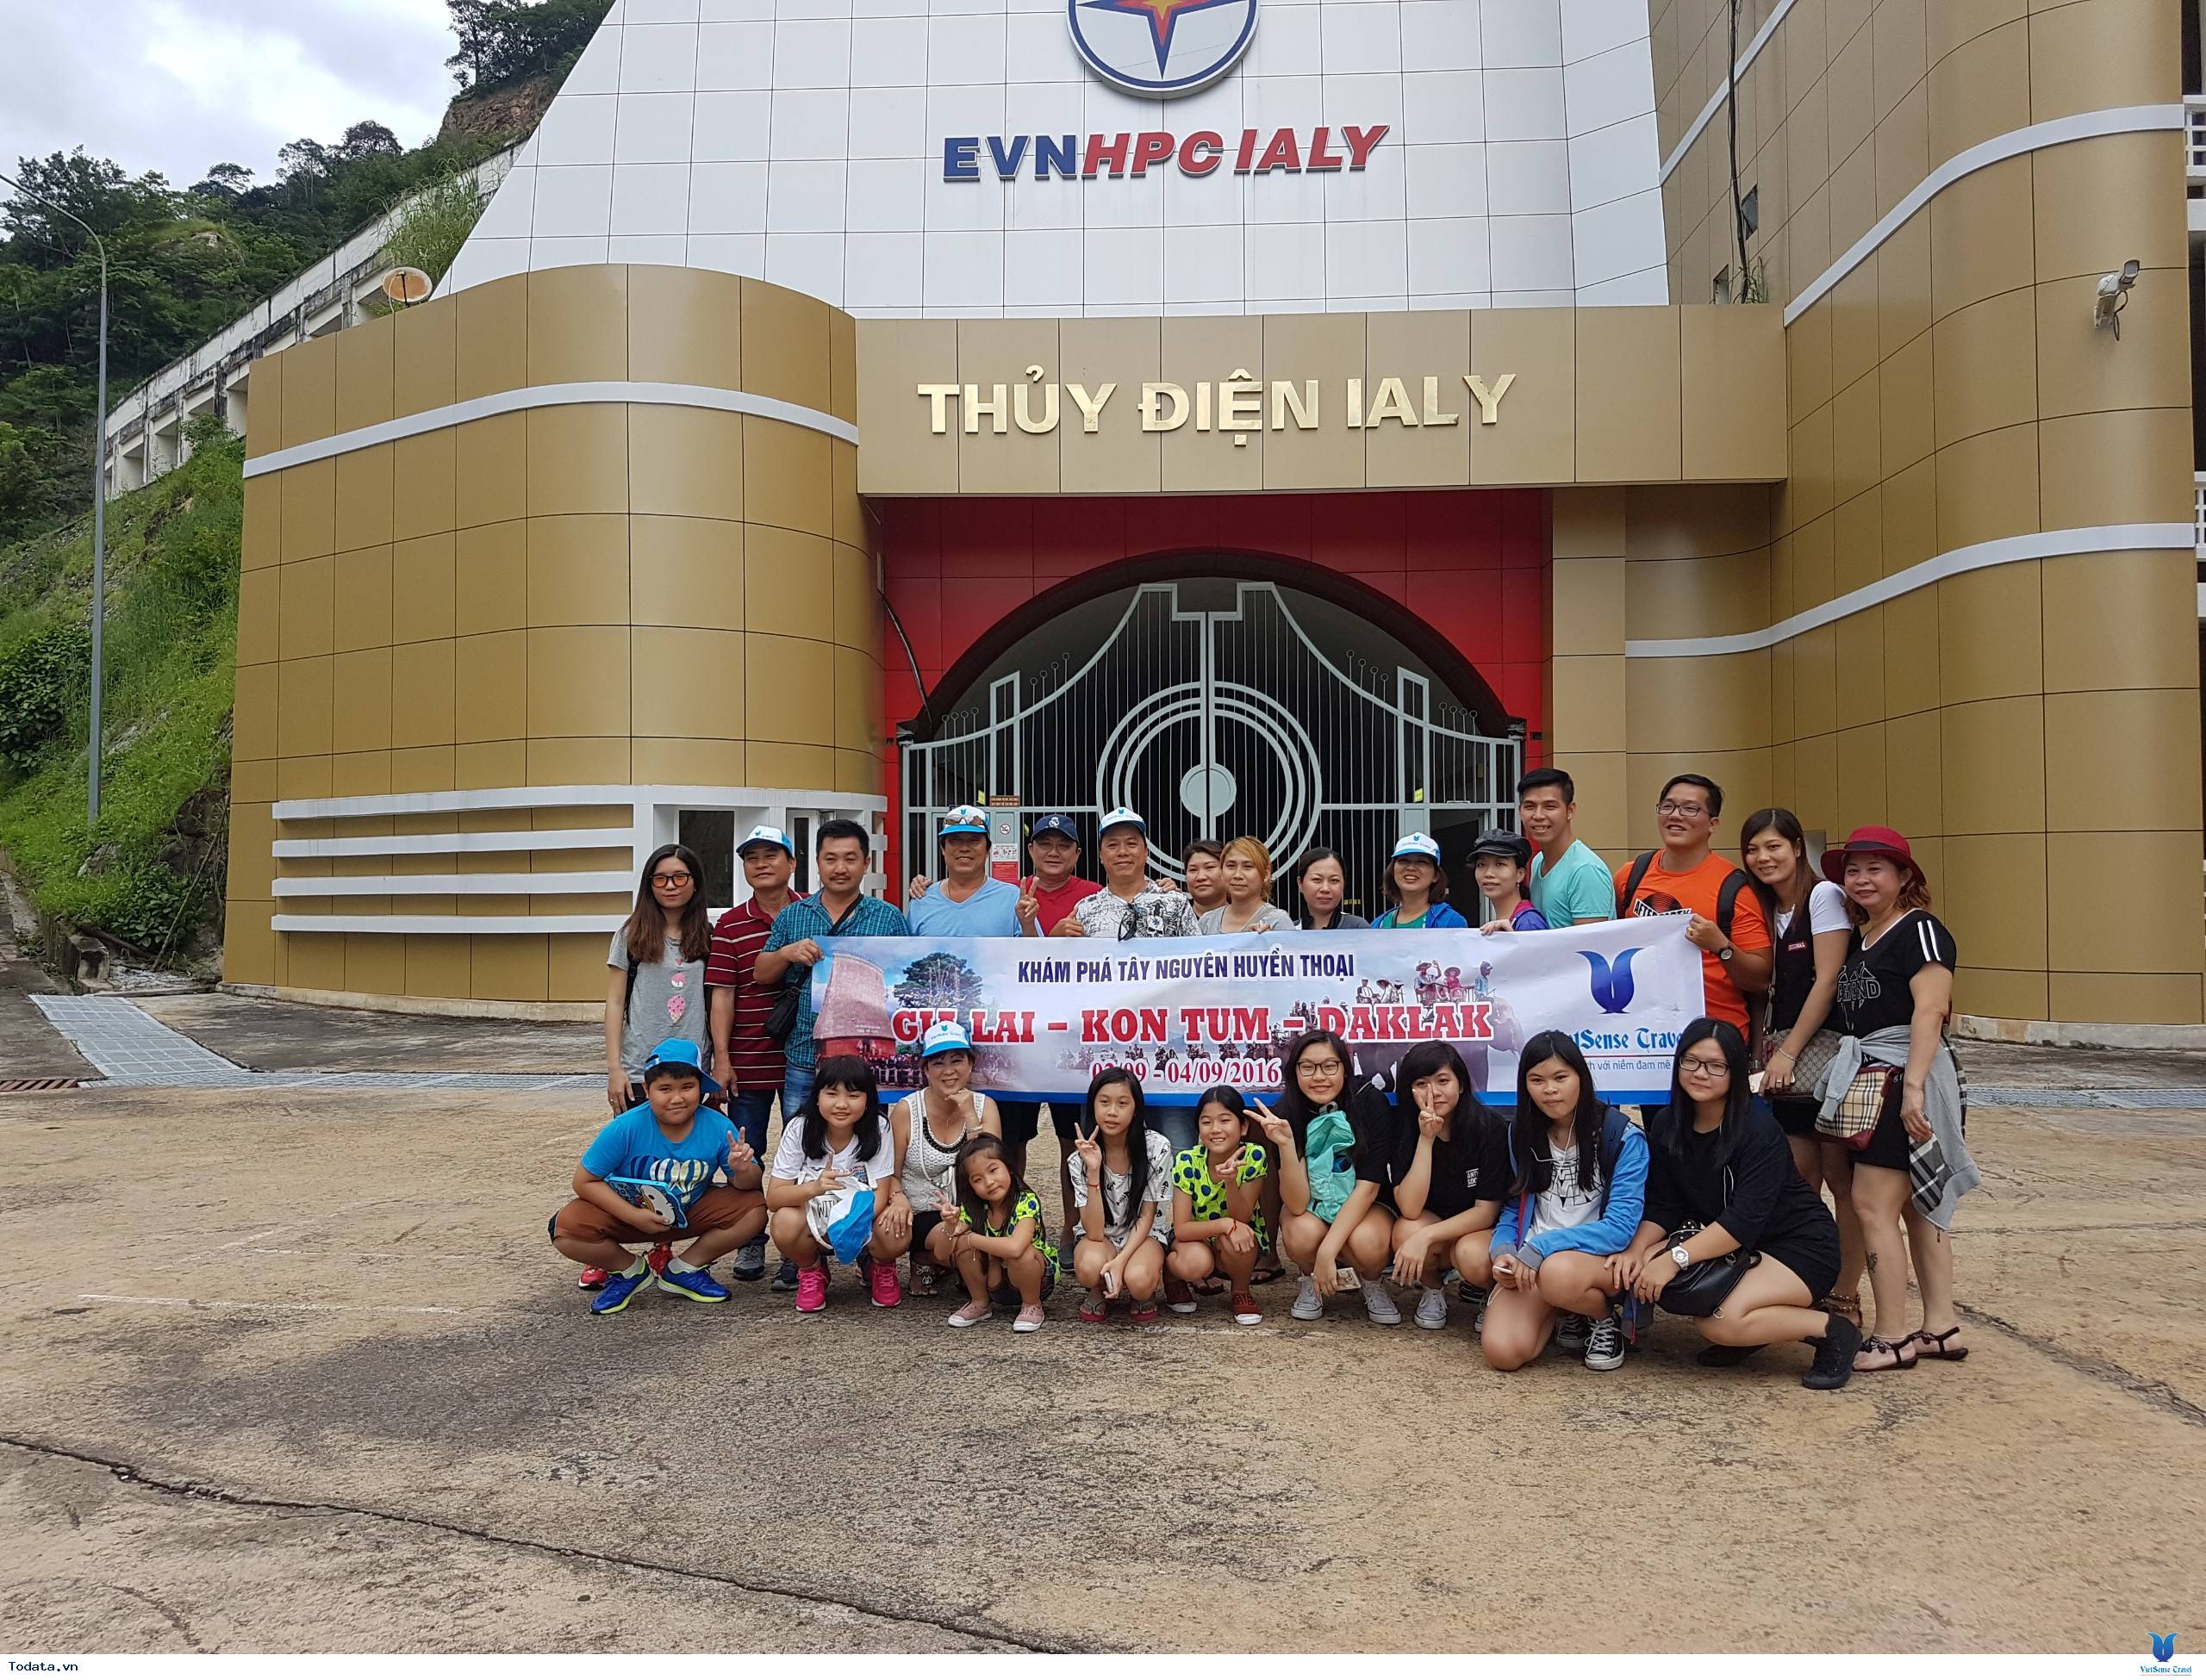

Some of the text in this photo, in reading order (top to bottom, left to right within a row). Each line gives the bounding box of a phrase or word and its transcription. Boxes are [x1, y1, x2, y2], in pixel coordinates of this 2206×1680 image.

[1233, 125, 1390, 174] IALY
[918, 364, 1517, 446] THỦY ĐIỆN IALY
[1018, 948, 1355, 983] KHÁM PHÁ TÂY NGUYÊN HUYỀN THOẠI
[971, 1011, 1035, 1042] LAI
[1081, 1008, 1168, 1042] KON
[1181, 1007, 1272, 1042] TUM
[1317, 1005, 1492, 1040] DAKLAK
[1168, 1061, 1280, 1083] 04/09/2016
[1597, 1060, 1611, 1070] với
[1636, 1060, 1655, 1070] đam
[1657, 1060, 1671, 1070] mê
